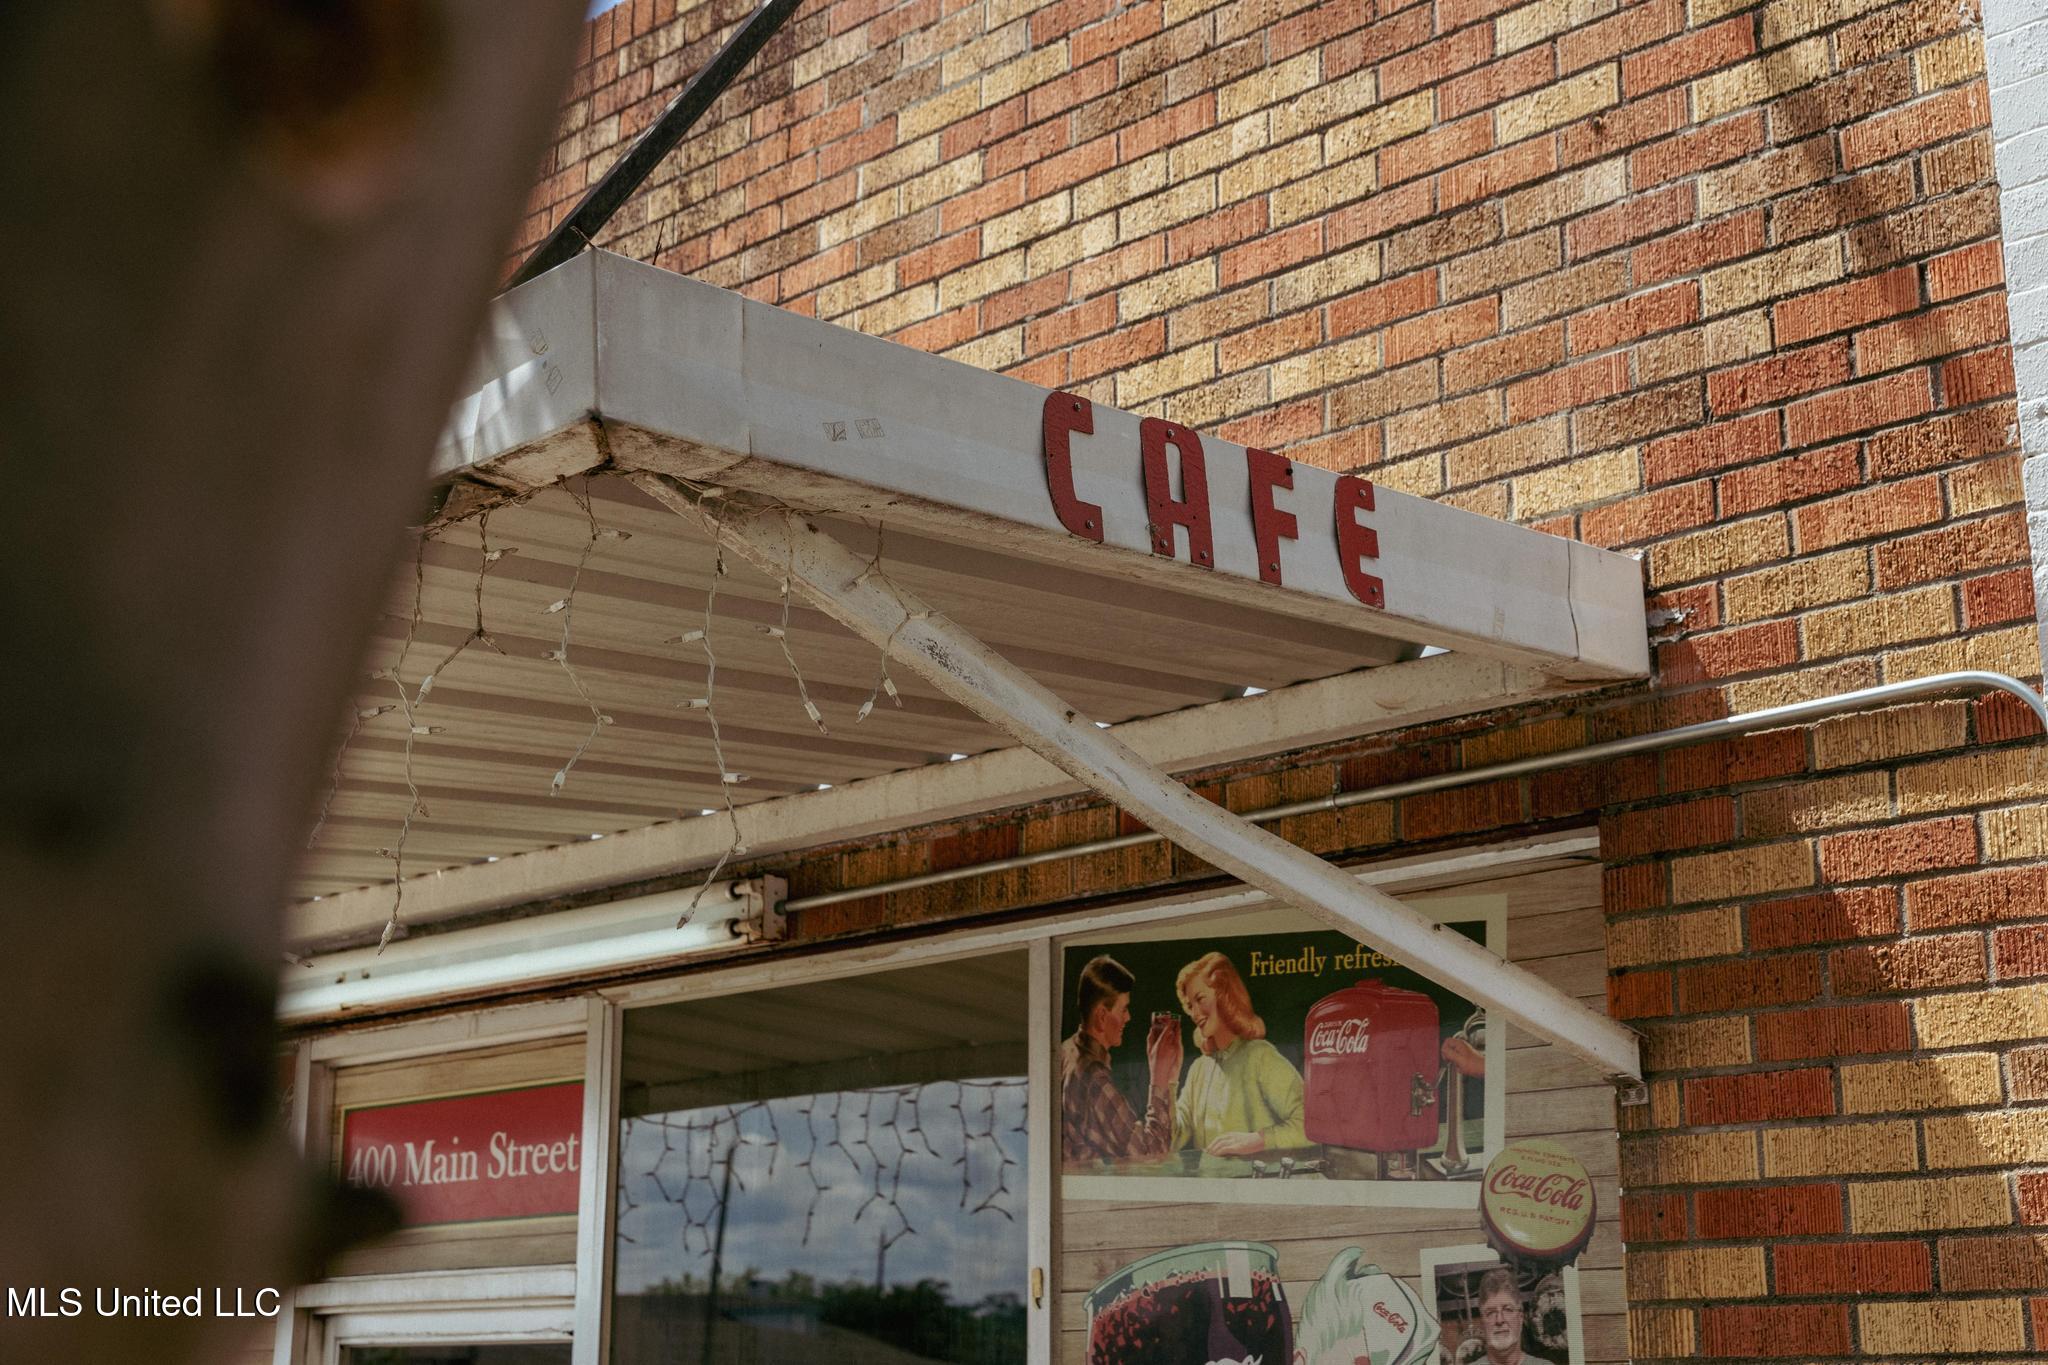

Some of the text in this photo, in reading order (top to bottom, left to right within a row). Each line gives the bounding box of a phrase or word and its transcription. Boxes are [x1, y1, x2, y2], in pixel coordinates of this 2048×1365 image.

[1043, 390, 1385, 609] CAFE
[1250, 944, 1402, 978] Friendly refres
[347, 1131, 580, 1188] 400 Main Street
